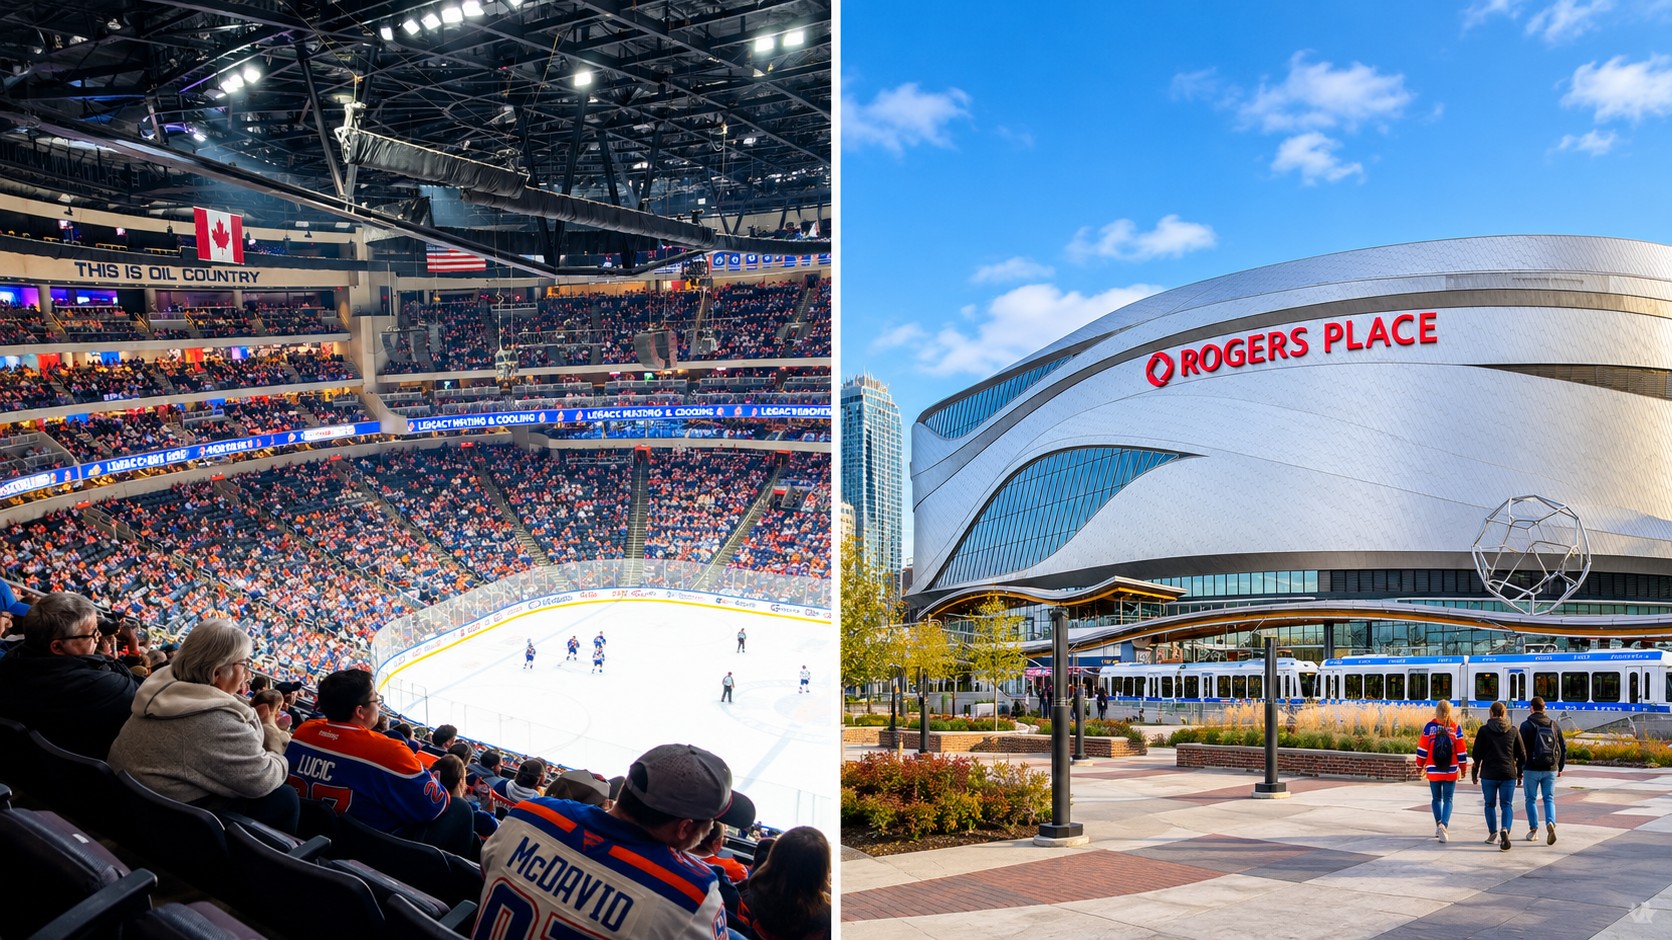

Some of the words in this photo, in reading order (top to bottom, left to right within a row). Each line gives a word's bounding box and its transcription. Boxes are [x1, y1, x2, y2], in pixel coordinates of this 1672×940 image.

[74, 261, 119, 278] THIS
[125, 265, 143, 279] IS
[149, 266, 177, 281] OIL
[182, 268, 260, 283] COUNTRY
[1180, 327, 1309, 377] ROGERS
[1323, 312, 1438, 353] PLACE
[297, 754, 336, 782] LUCIC
[506, 836, 634, 932] McDAVID
